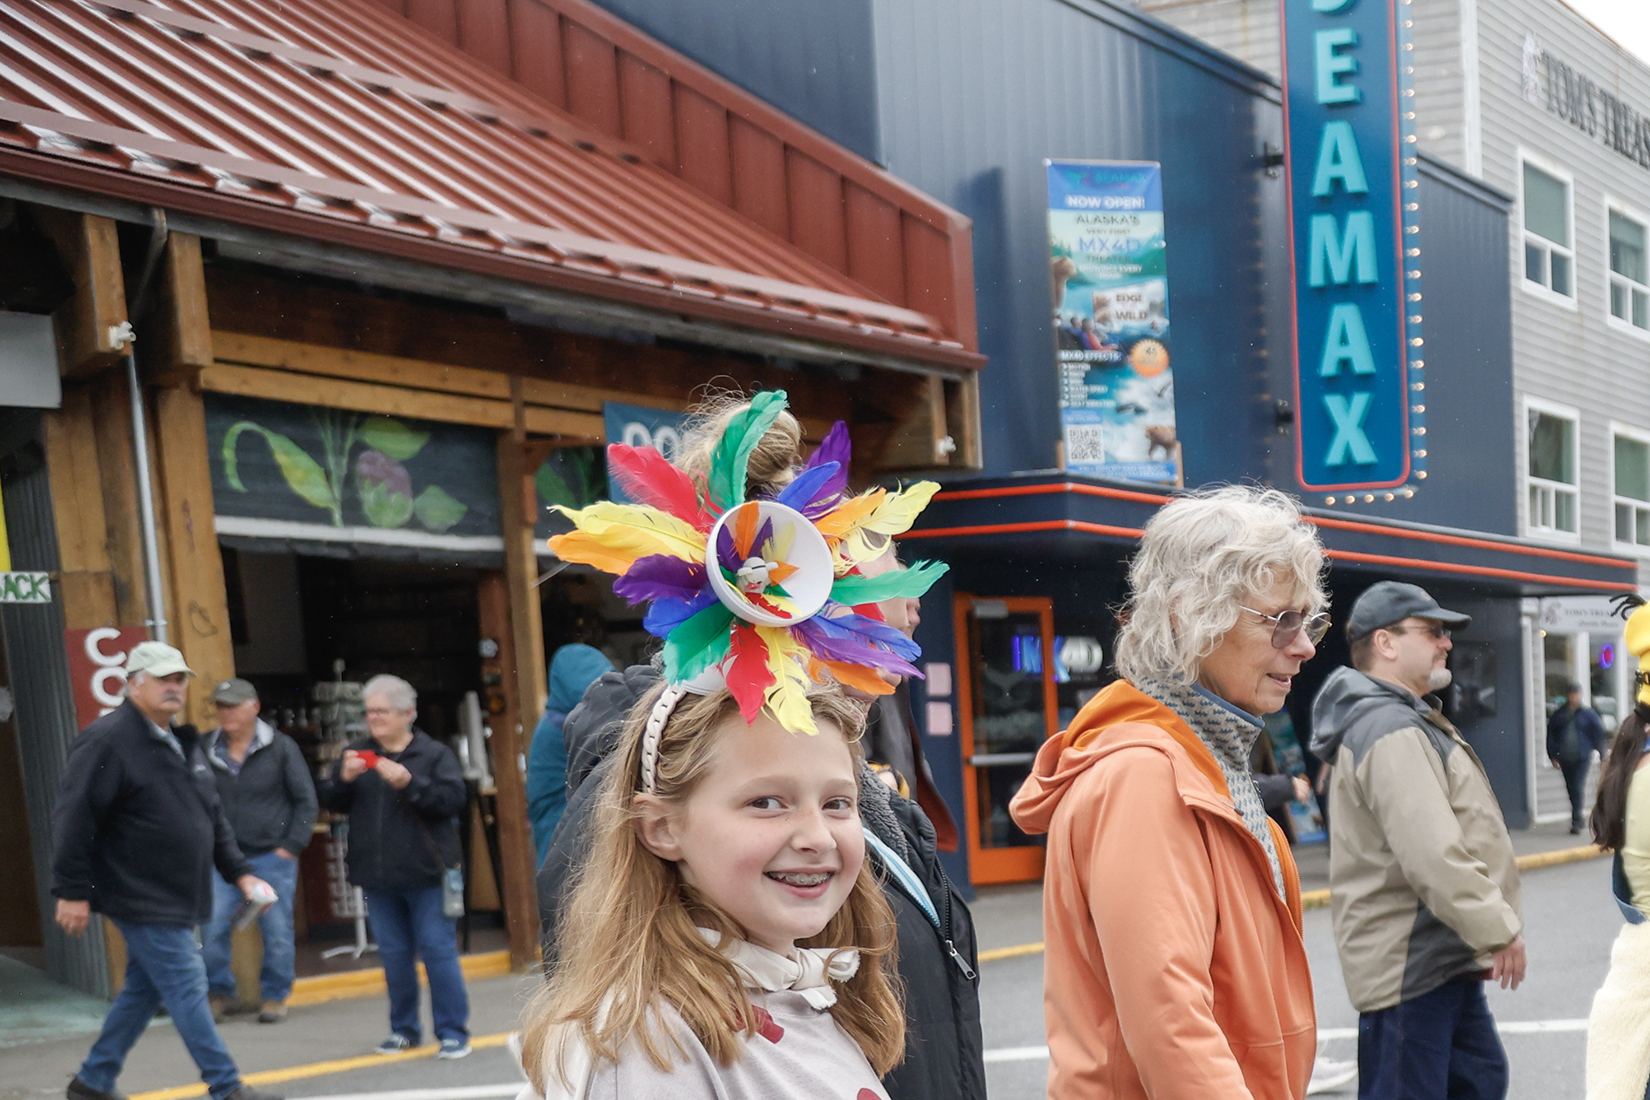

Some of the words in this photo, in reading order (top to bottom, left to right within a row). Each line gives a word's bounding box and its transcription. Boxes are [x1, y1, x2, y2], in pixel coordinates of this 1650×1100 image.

[1540, 51, 1597, 138] TOM'S
[1065, 195, 1101, 208] NOW
[1103, 195, 1145, 209] OPEN!
[1076, 213, 1141, 226] ALASKA'S
[1308, 0, 1379, 467] EAMAX
[1079, 237, 1140, 253] MX4D
[0, 573, 51, 600] ACK
